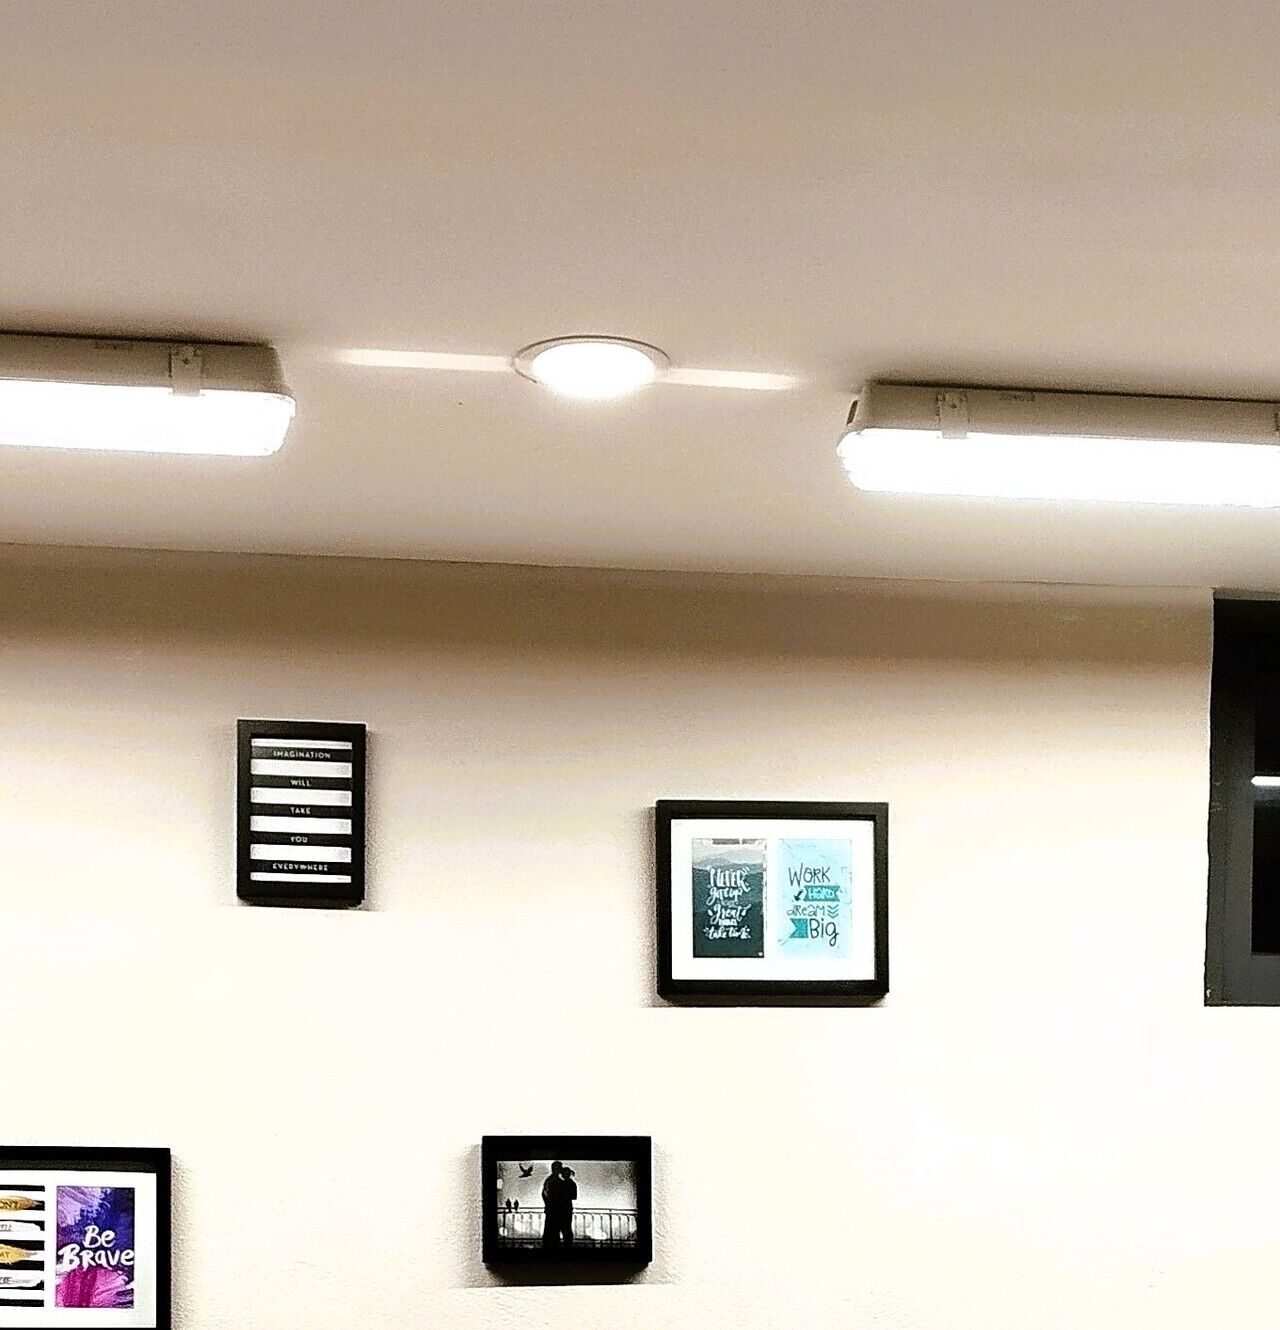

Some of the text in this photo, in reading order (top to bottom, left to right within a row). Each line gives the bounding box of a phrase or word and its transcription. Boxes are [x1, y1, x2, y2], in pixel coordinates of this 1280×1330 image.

[273, 750, 331, 759] IMAGINATION
[291, 779, 311, 787] WILL
[290, 806, 311, 815] TAKE
[272, 863, 329, 871] EVERYWHERE
[788, 862, 831, 887] WORK
[809, 918, 840, 947] Big
[83, 1225, 116, 1250] Be
